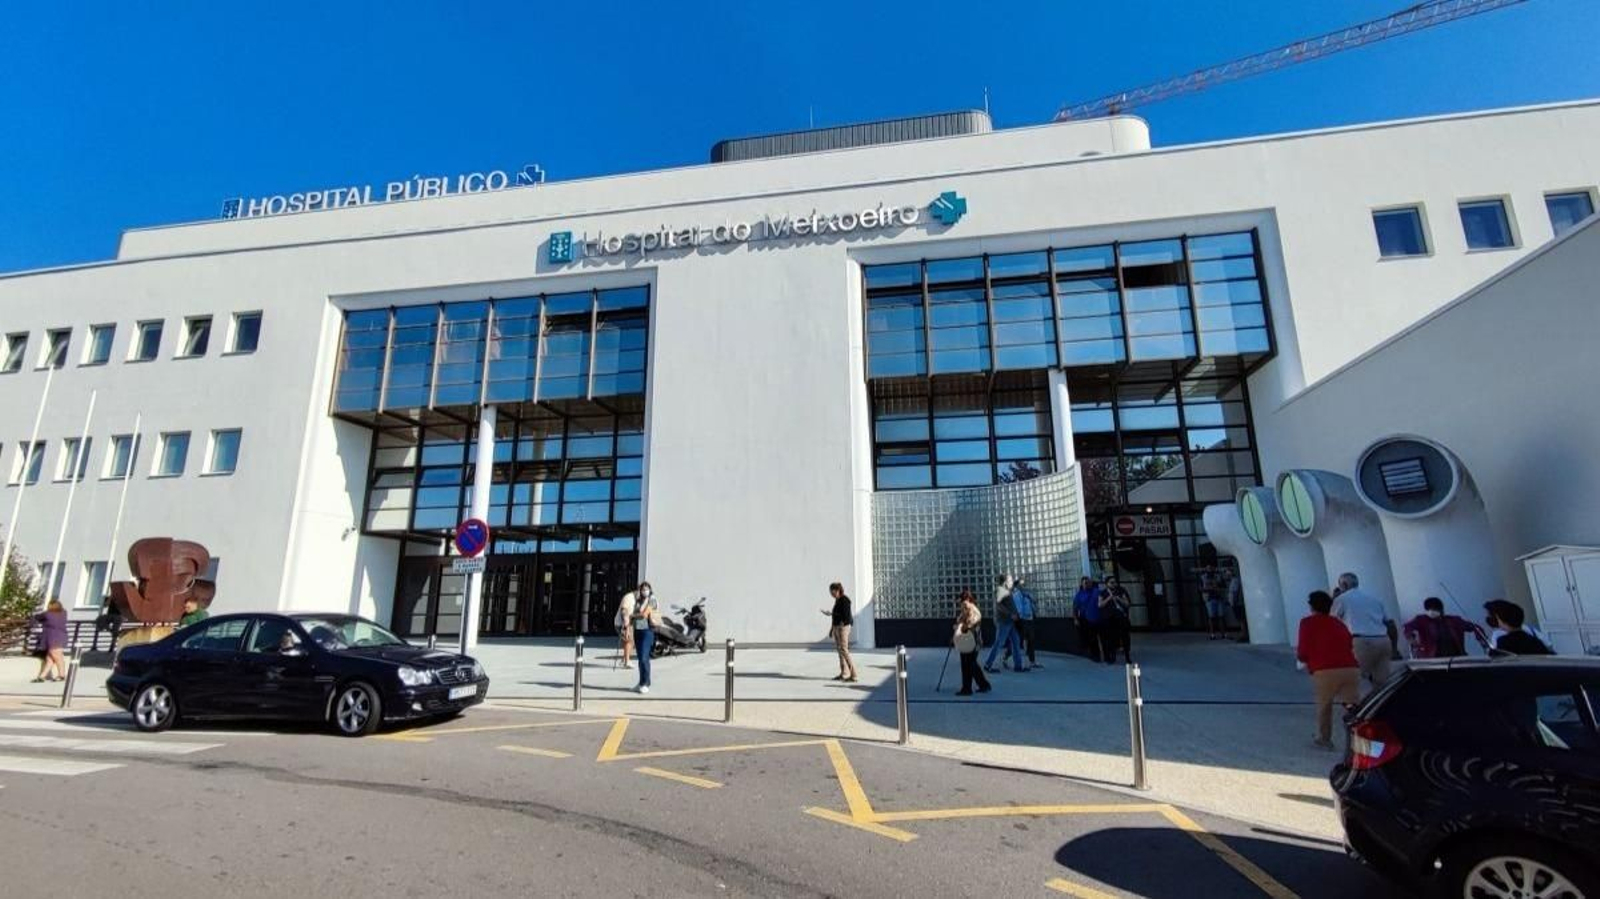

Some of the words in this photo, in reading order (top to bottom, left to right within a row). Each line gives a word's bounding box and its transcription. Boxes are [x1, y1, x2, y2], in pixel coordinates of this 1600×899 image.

[247, 185, 374, 218] HOSPITAL
[385, 171, 509, 202] PÚBLICO
[583, 223, 703, 257] Hospital
[712, 217, 752, 243] do
[762, 202, 919, 237] Meixoeiro
[1139, 525, 1169, 534] PASAR
[1142, 516, 1163, 524] NON
